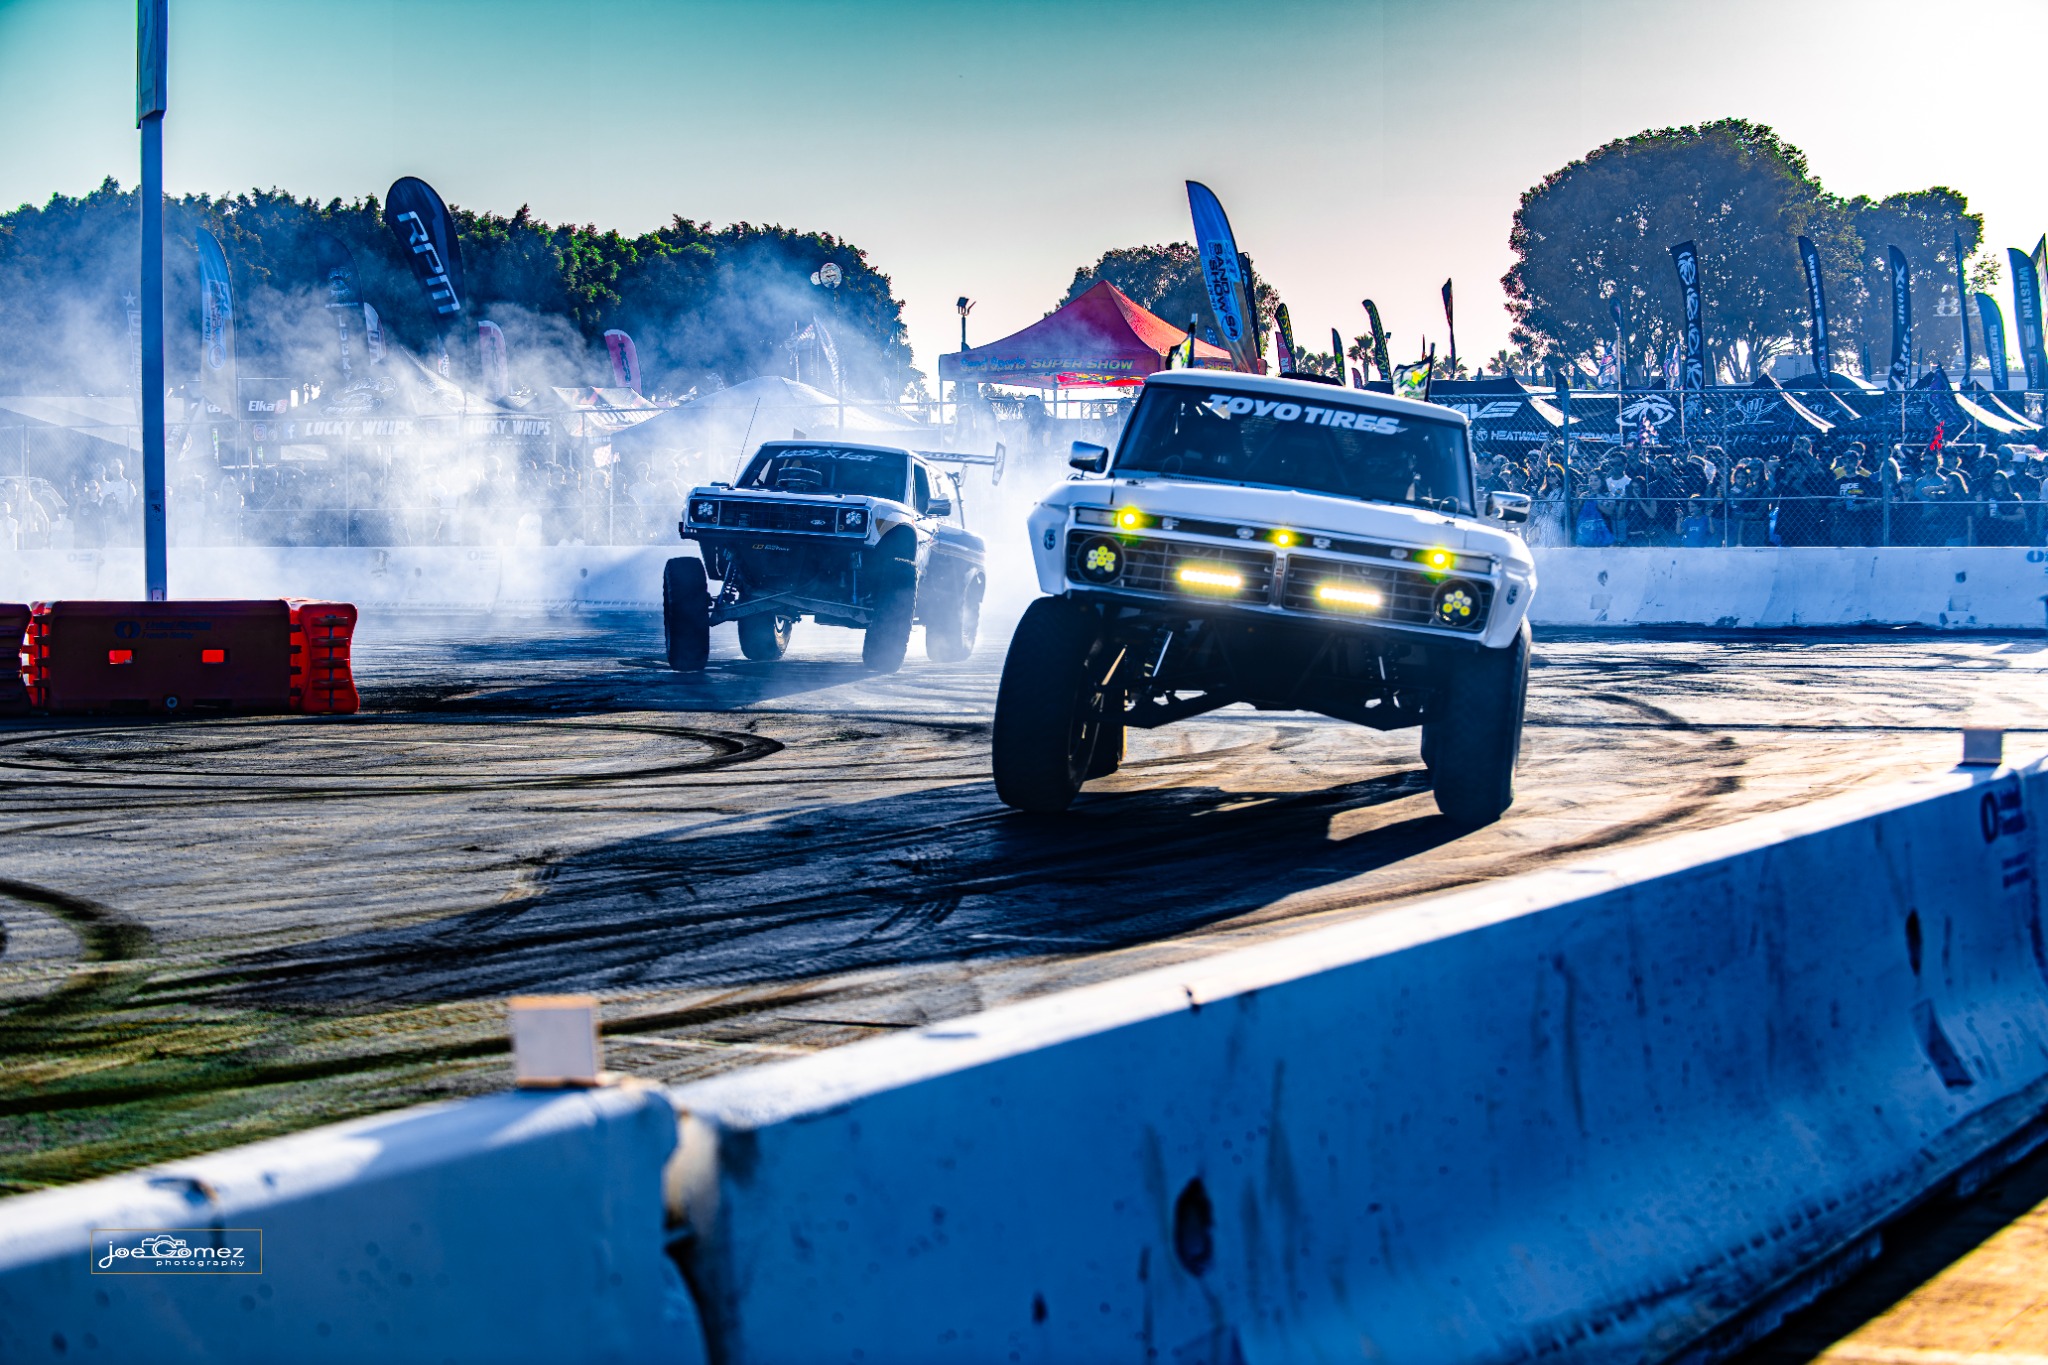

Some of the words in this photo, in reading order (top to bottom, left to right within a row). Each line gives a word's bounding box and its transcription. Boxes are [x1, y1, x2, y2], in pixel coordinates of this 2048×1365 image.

[397, 211, 460, 314] RPM
[1214, 242, 1230, 294] SAND
[1208, 258, 1228, 313] SHOW
[1030, 358, 1082, 369] SUPER
[1086, 359, 1136, 370] SHOW
[248, 400, 275, 412] Elka
[1208, 393, 1302, 422] TOYO
[1303, 406, 1401, 435] TIRES
[1490, 430, 1550, 442] HEATWAVE
